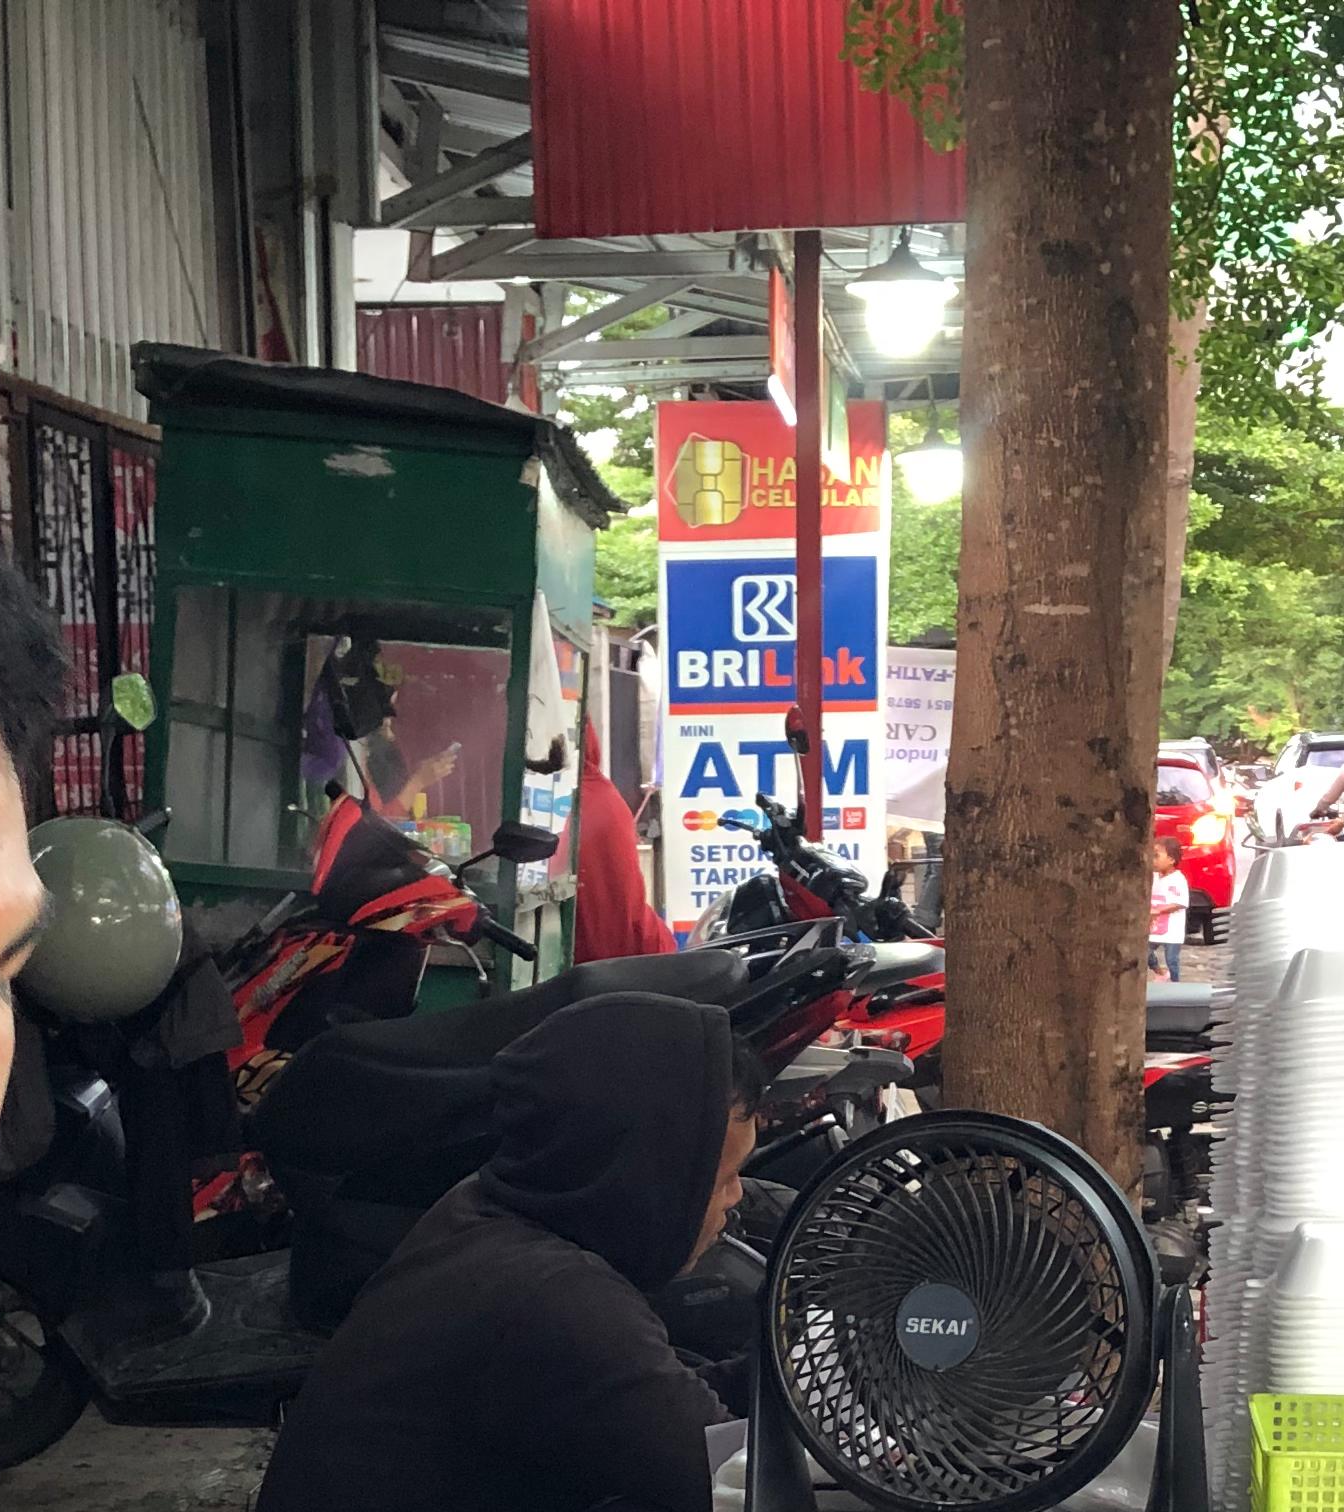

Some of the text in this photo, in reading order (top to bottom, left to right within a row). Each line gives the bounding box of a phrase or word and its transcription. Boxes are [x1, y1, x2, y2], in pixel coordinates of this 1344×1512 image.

[752, 456, 878, 486] HAN
[677, 647, 866, 688] BRILnk
[679, 725, 714, 737] MINI
[680, 739, 870, 798] ATM
[905, 1317, 968, 1336] SEKAI
